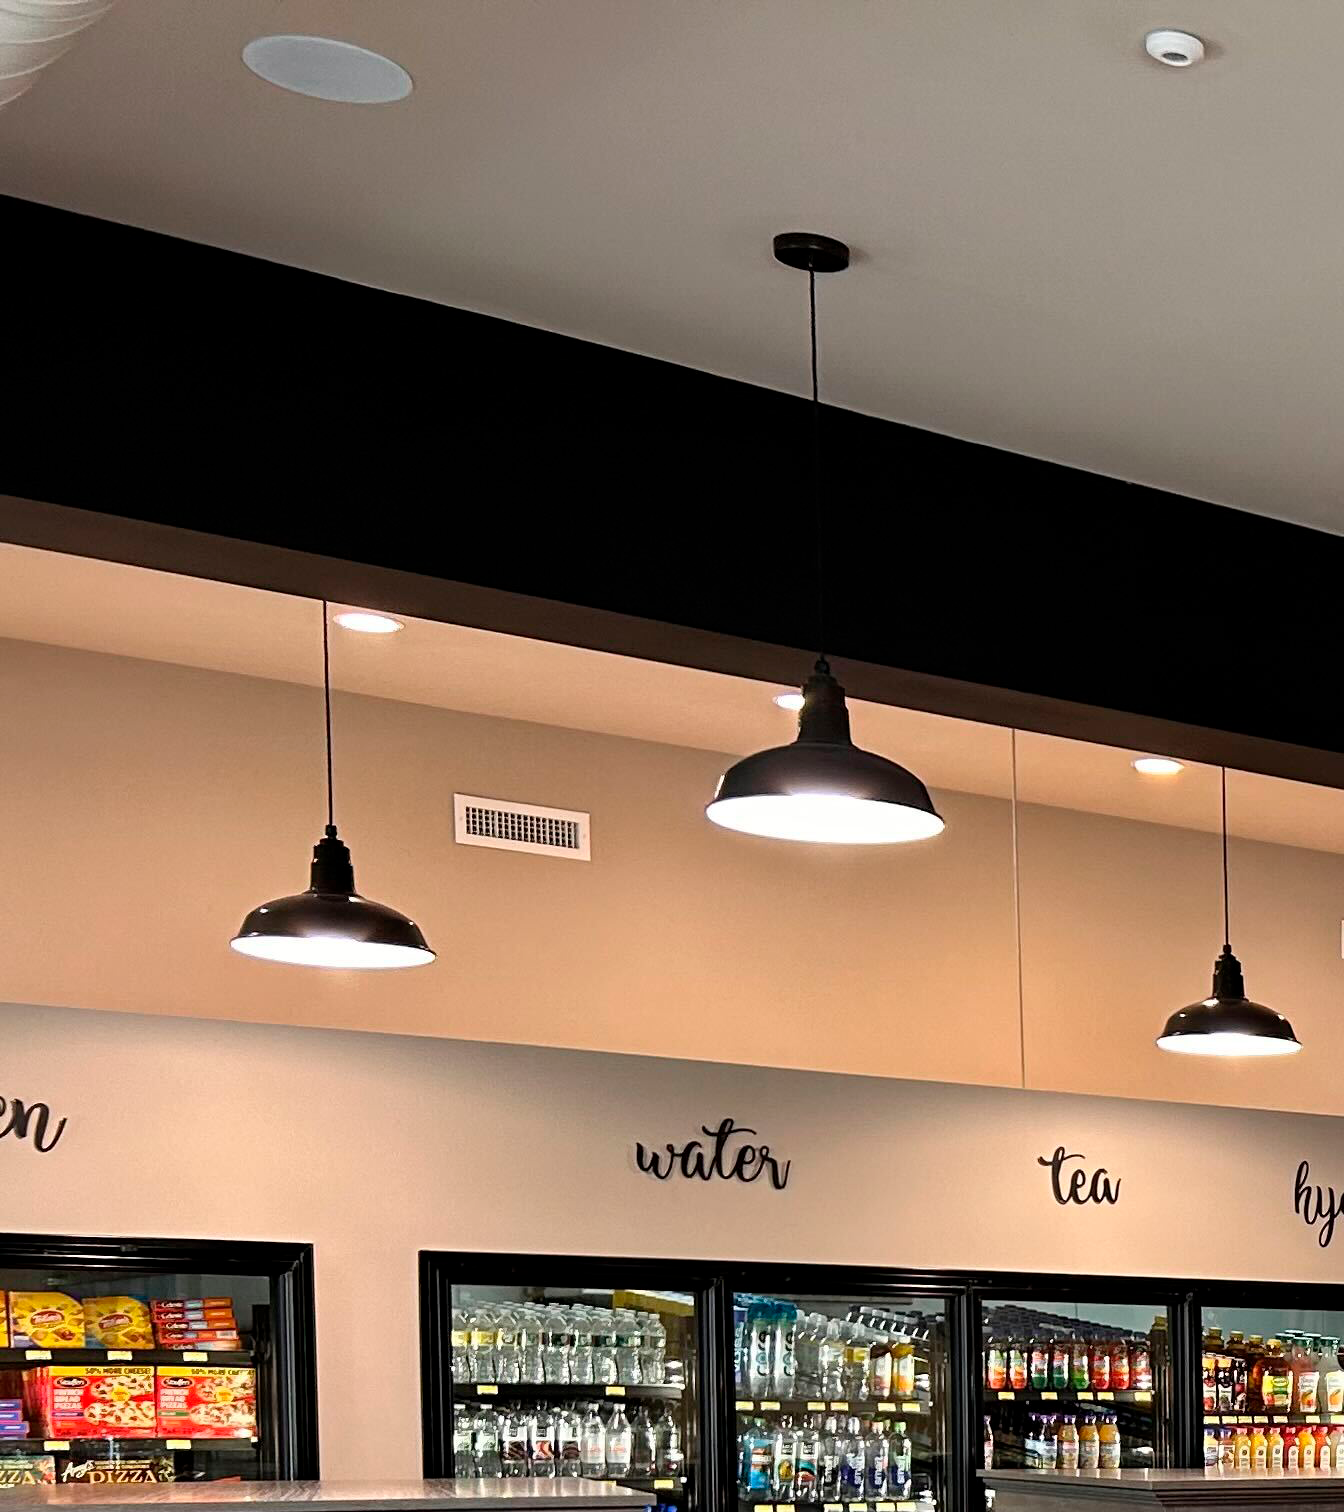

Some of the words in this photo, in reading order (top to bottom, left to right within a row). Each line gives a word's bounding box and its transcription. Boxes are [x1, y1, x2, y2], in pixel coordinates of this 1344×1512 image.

[635, 1117, 791, 1190] water
[1037, 1146, 1121, 1205] tea
[0, 1470, 35, 1484] ZZA
[88, 1470, 158, 1483] PIZZA
